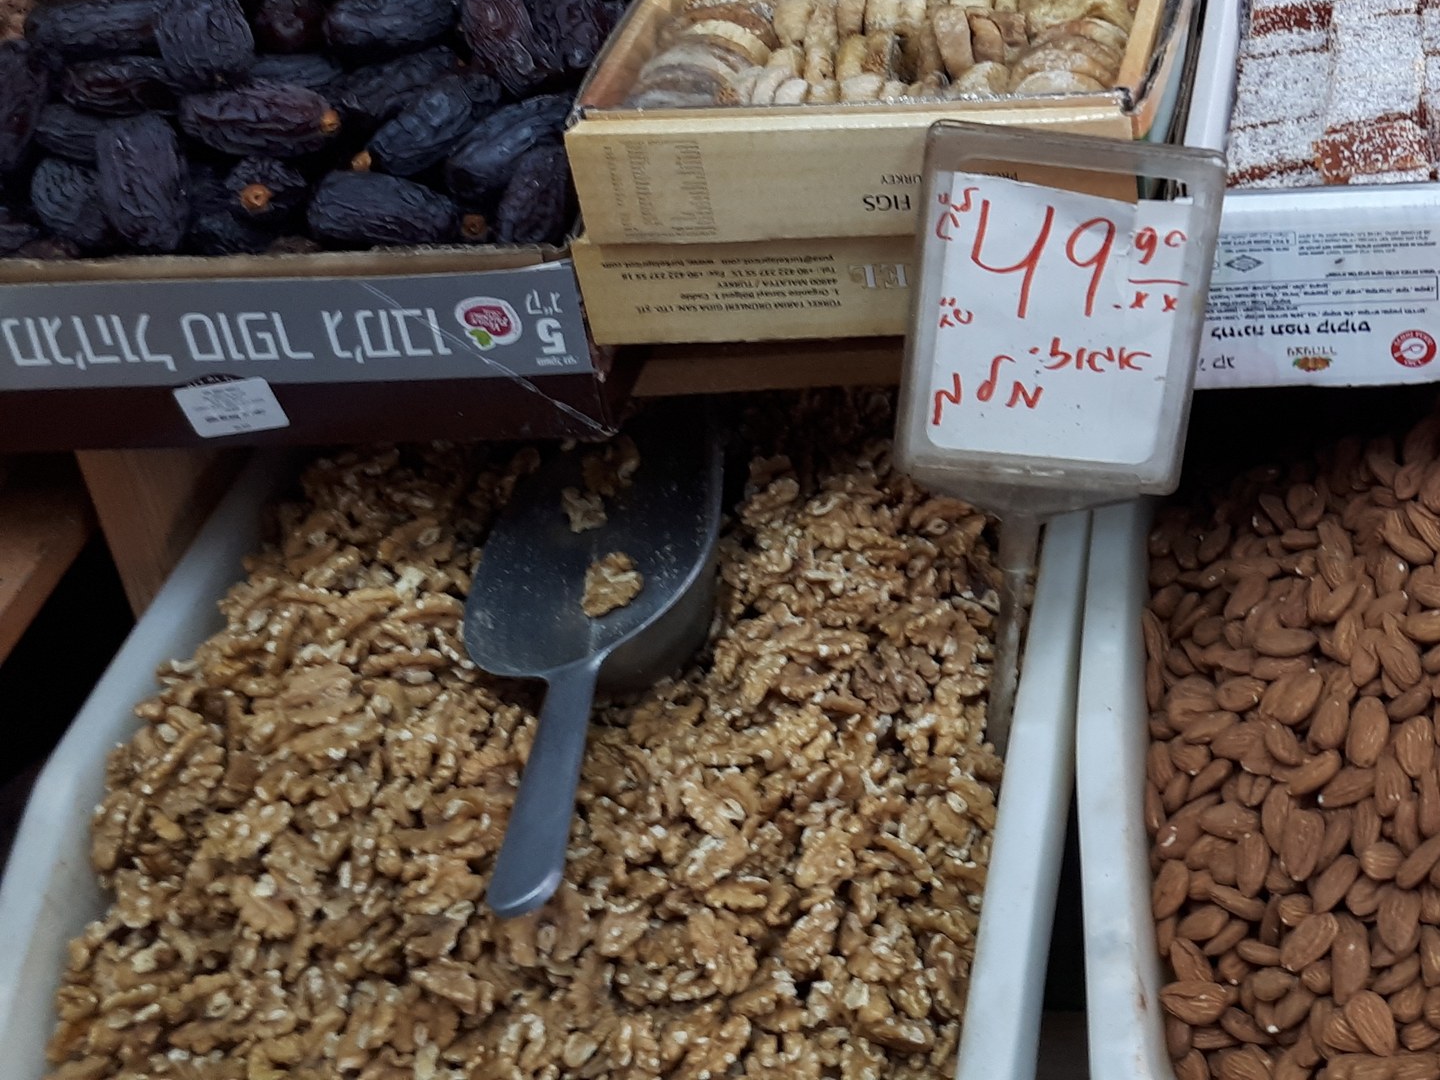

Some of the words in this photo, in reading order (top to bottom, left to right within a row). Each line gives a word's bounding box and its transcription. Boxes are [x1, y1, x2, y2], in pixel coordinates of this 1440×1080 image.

[863, 194, 911, 212] FIGS
[970, 199, 1117, 319] 49
[717, 279, 754, 289] TURKEY
[525, 287, 563, 316] ק"ג
[1, 314, 178, 373] מג'הול
[179, 311, 317, 363] סופר
[320, 307, 455, 366] ג'מבו
[536, 318, 567, 355] 5
[1211, 324, 1264, 340] לוזינה
[1270, 323, 1310, 337] תפוז
[1316, 319, 1372, 336] קוקוס
[1212, 355, 1236, 370] קג
